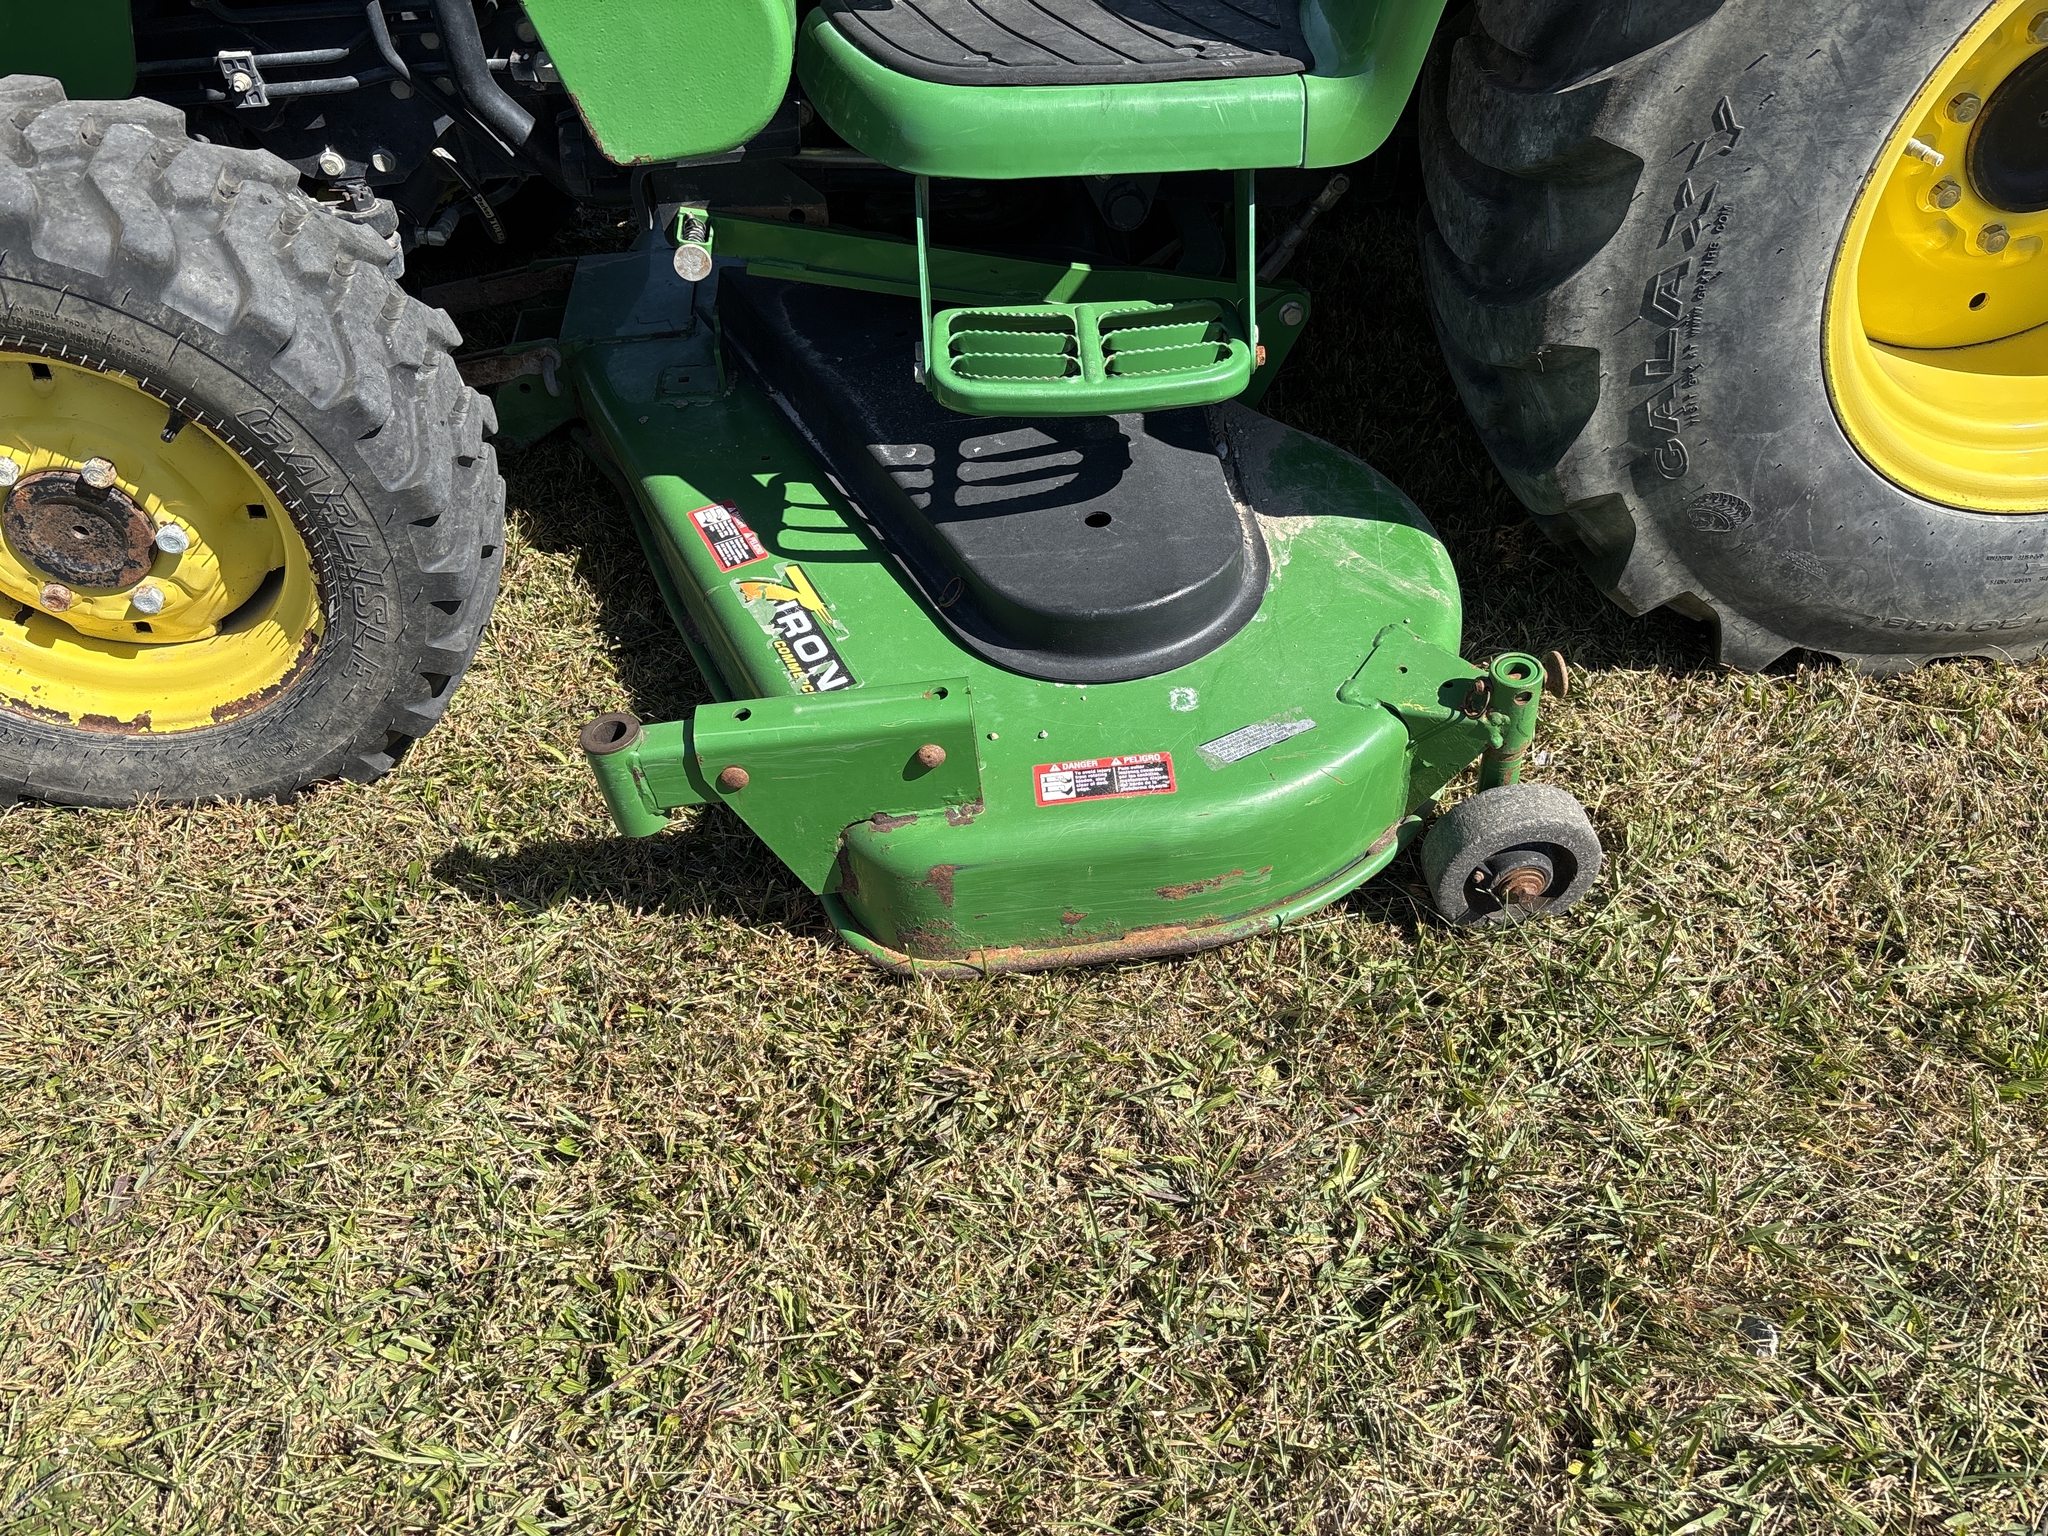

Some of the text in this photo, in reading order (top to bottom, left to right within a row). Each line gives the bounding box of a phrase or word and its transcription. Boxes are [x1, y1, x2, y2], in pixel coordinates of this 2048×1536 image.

[1645, 96, 1744, 480] GALAXY
[30, 309, 59, 320] RESULT
[64, 317, 87, 329] FROM
[235, 406, 388, 690] CARLISLE
[748, 536, 765, 555] PELIGRO
[333, 551, 346, 571] THE
[775, 600, 849, 692] IRON
[1062, 760, 1098, 770] DANGER
[1123, 754, 1160, 764] PELIGRO
